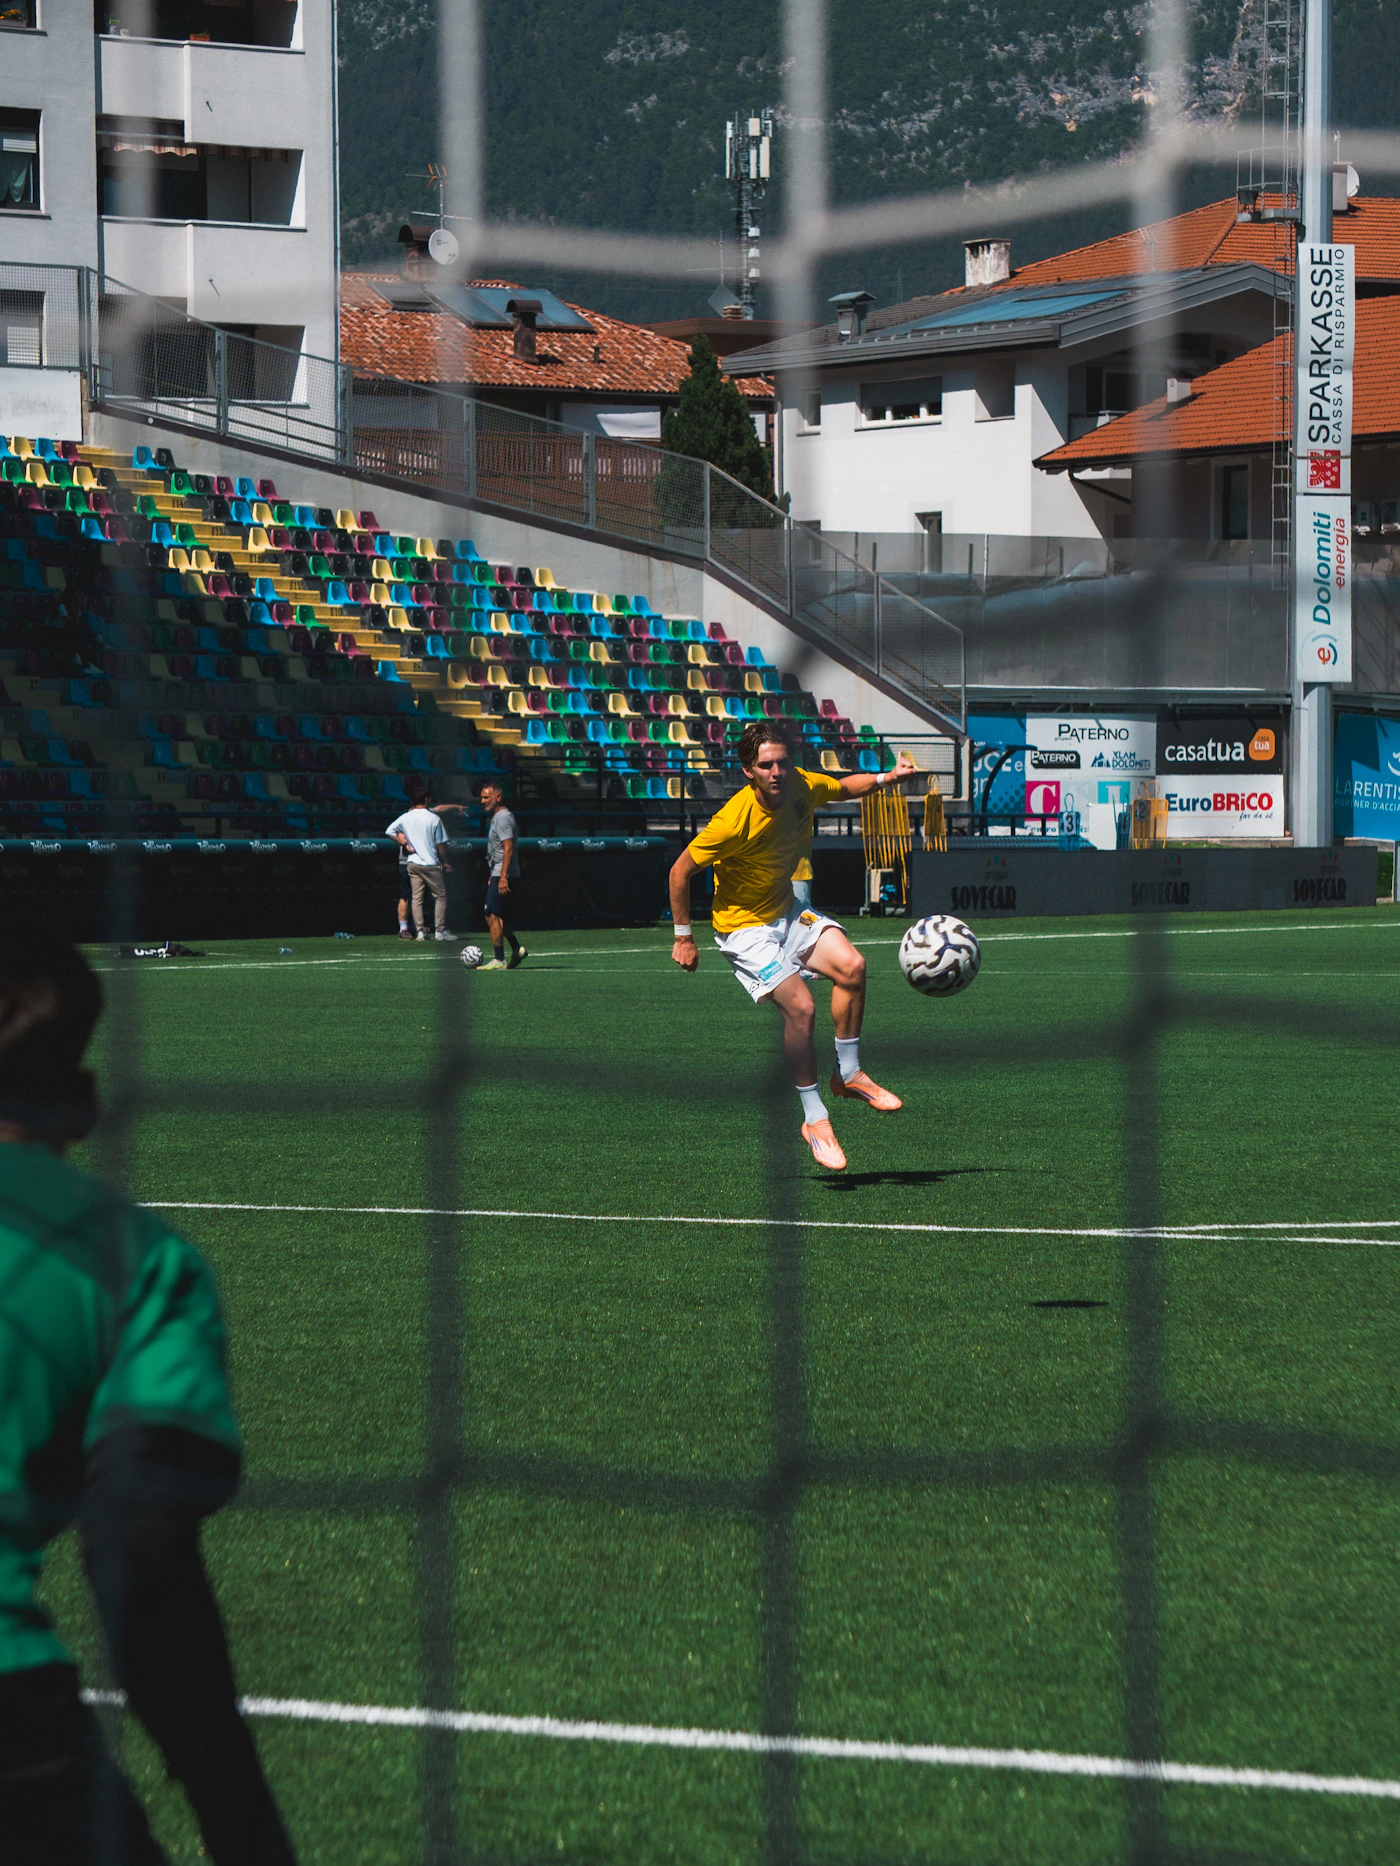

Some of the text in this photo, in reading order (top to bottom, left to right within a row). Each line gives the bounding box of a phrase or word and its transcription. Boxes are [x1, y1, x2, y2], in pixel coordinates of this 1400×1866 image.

[1308, 248, 1333, 443] SPARKASSE
[1332, 249, 1345, 444] CASSA DI RISPARMIO
[1334, 518, 1348, 590] energia
[1313, 511, 1331, 625] Dolomiti
[1058, 724, 1129, 743] PATERNO
[1254, 740, 1270, 750] tua
[1031, 750, 1077, 764] PATERNO
[1165, 737, 1245, 762] casatua
[1065, 815, 1074, 832] 3
[951, 886, 1017, 911] SOVECAR
[1131, 881, 1190, 906] SOVECAR
[1293, 878, 1347, 901] SOVECAR
